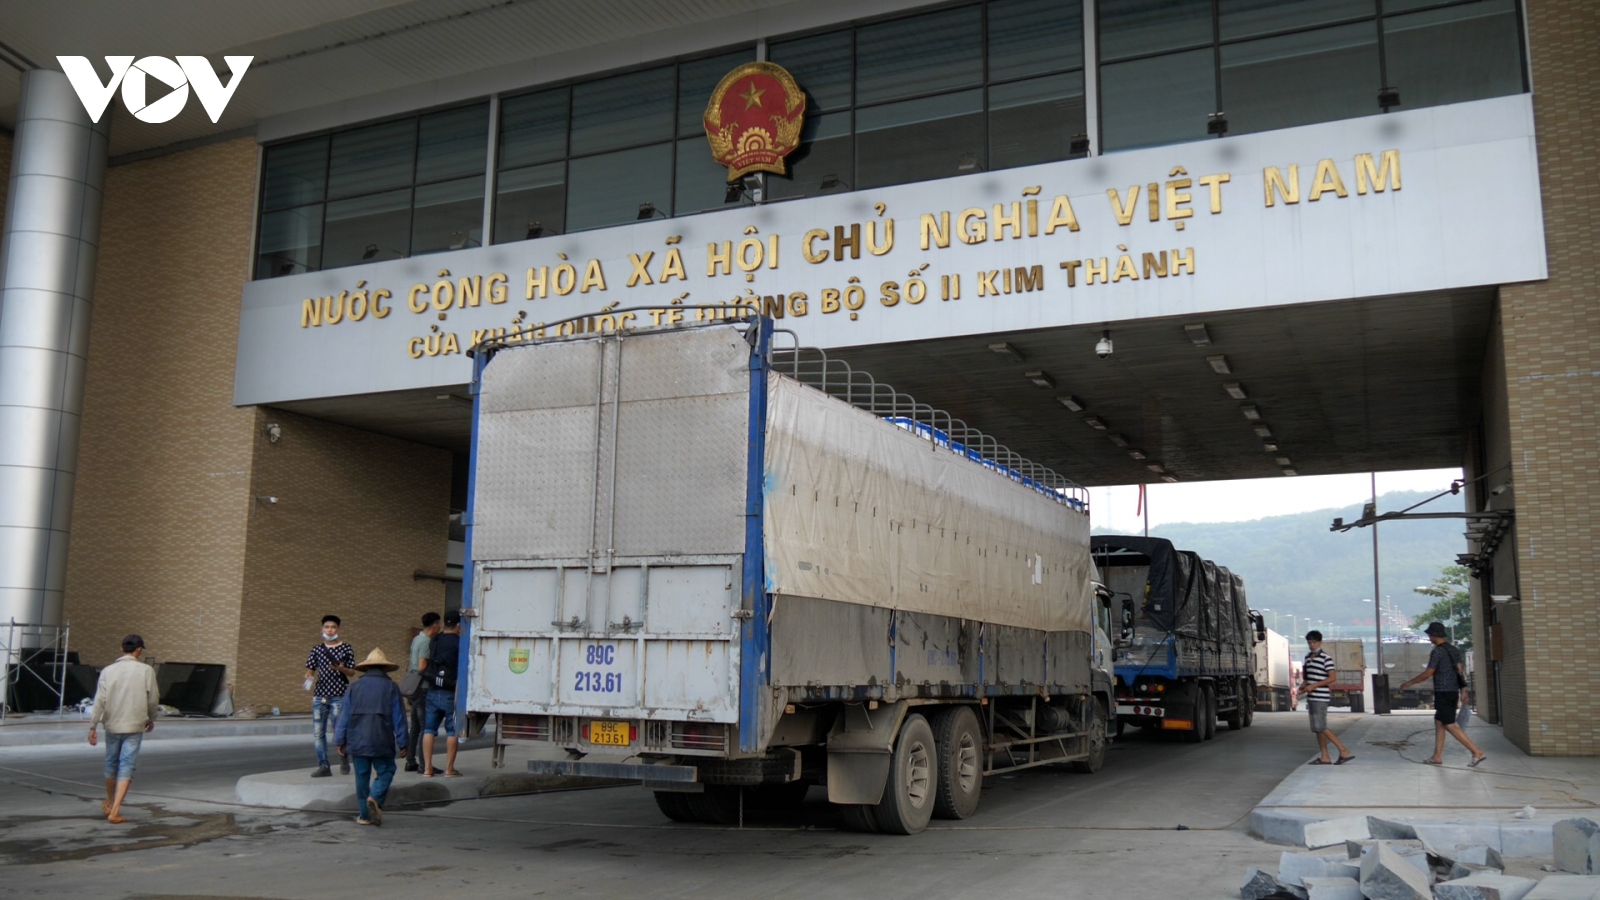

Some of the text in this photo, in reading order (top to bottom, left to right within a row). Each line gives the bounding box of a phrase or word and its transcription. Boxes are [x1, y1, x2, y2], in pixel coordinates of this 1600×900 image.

[301, 149, 1402, 329] NƯỚC CỘNG HÒA XÃ HỘI CHỦ NGHĨA VIỆT NAM
[407, 323, 461, 359] CỬA
[649, 292, 691, 327] TẾ
[821, 276, 866, 321] BỘ
[879, 263, 926, 307] SỐ
[941, 273, 961, 301] II
[977, 264, 1044, 298] KIM
[1060, 244, 1196, 288] THÀNH
[586, 644, 615, 666] 89C
[574, 671, 622, 693] 213.61
[594, 732, 624, 744] 213.61
[601, 722, 618, 733] 89C
